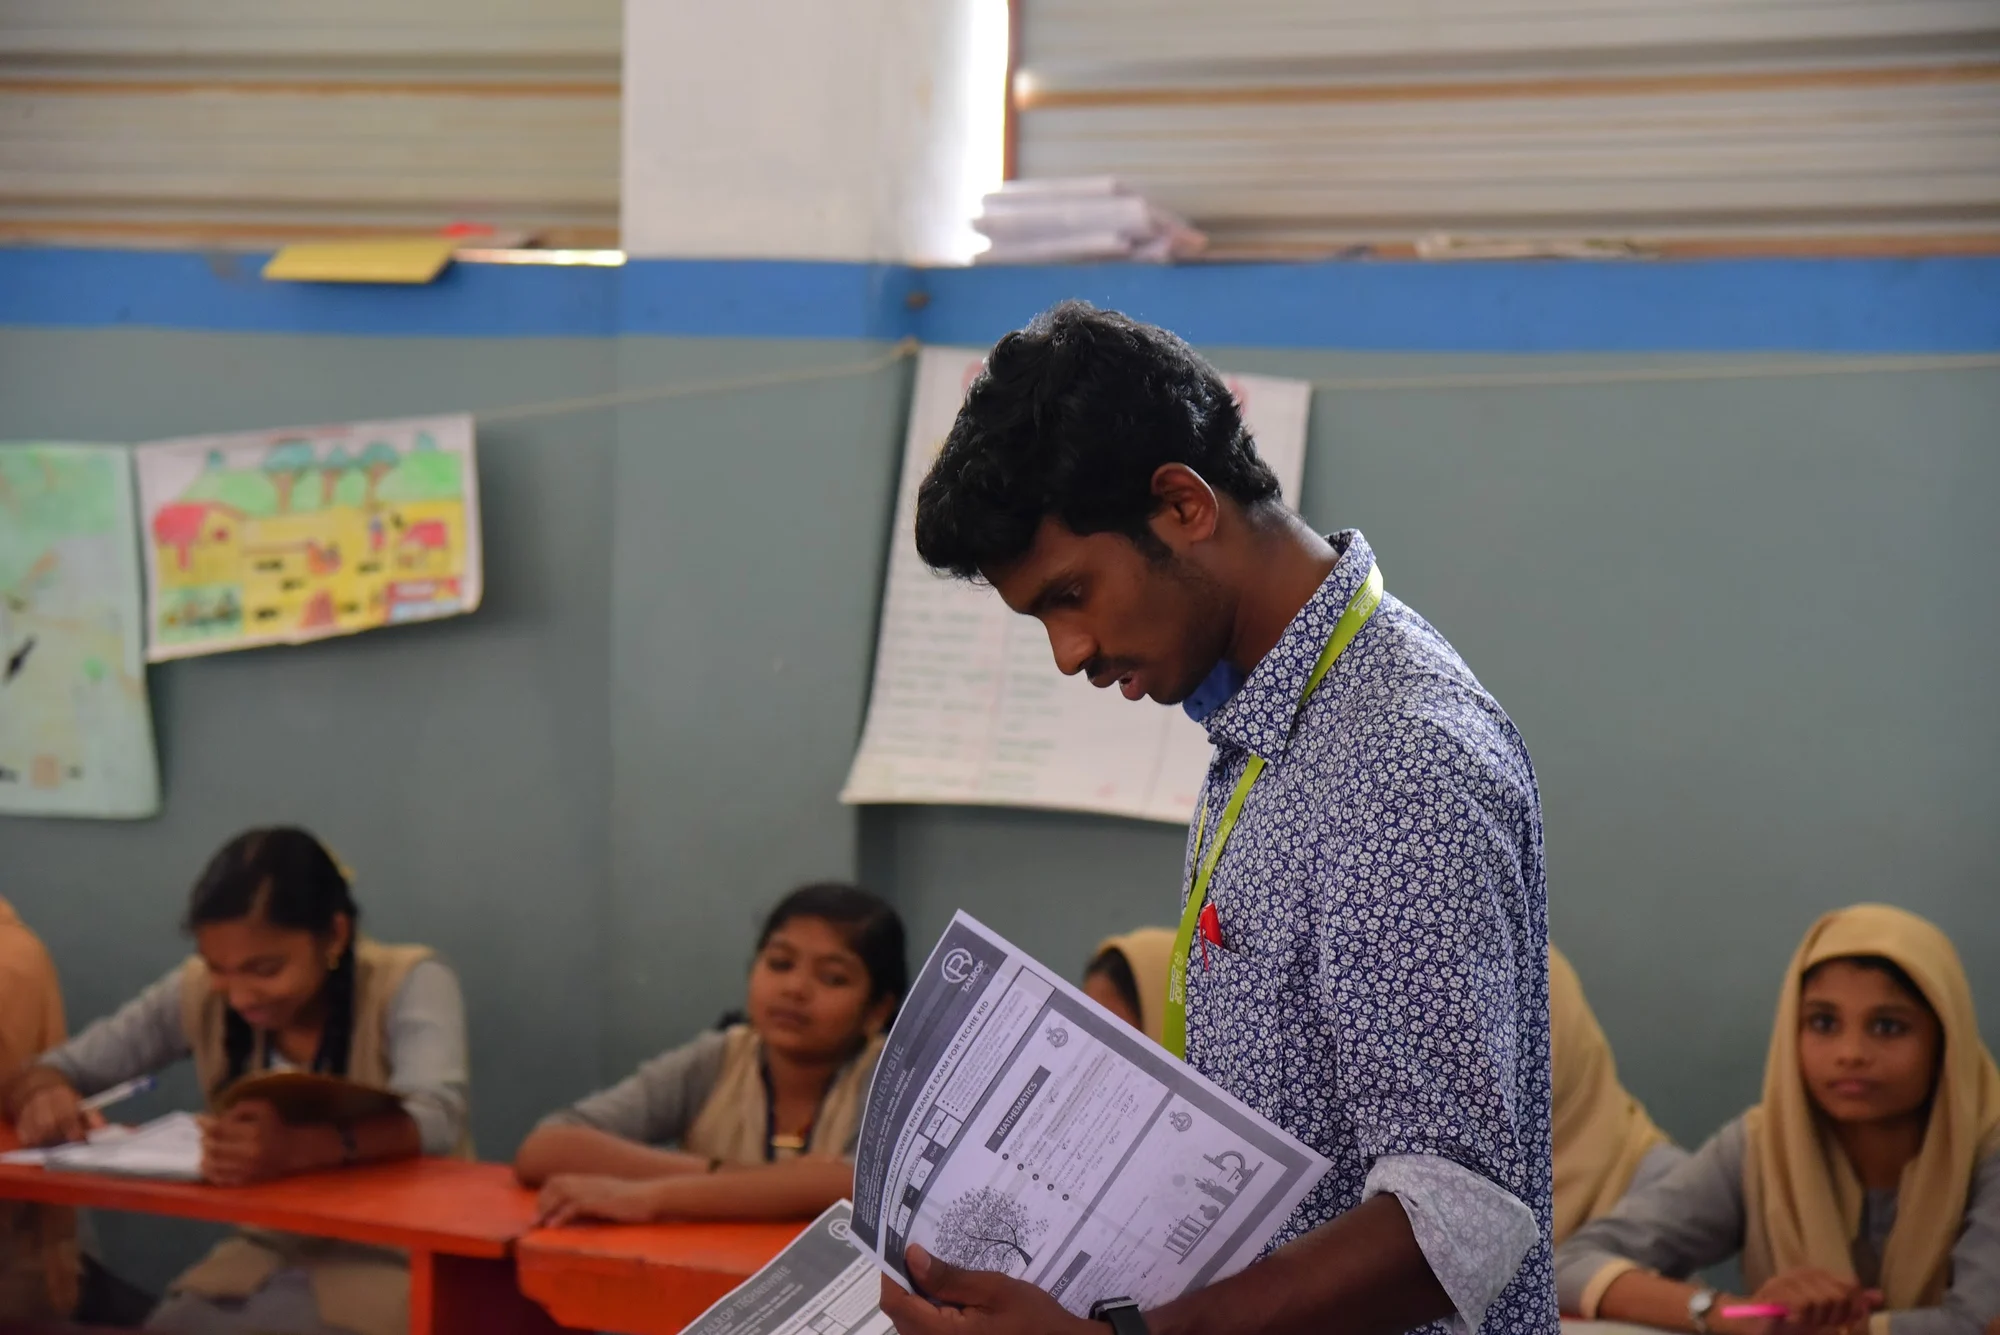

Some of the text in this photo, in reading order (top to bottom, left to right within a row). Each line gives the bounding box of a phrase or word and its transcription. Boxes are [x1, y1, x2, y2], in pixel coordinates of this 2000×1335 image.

[960, 958, 986, 993] TALROP
[1174, 967, 1183, 1005] TALROP
[863, 1042, 905, 1145] TECHNEWBIE
[881, 1184, 891, 1219] TALROP
[888, 1128, 911, 1182] TECHNEWBIE
[908, 1084, 935, 1128] ENTRANCE
[932, 1059, 950, 1084] EXAM
[947, 1042, 961, 1060] FOR
[957, 1014, 979, 1043] TECHIE
[976, 1000, 989, 1015] KID
[996, 1080, 1038, 1137] MATHEMATICS
[929, 1144, 938, 1157] DUR
[1049, 1274, 1071, 1299] IENCE
